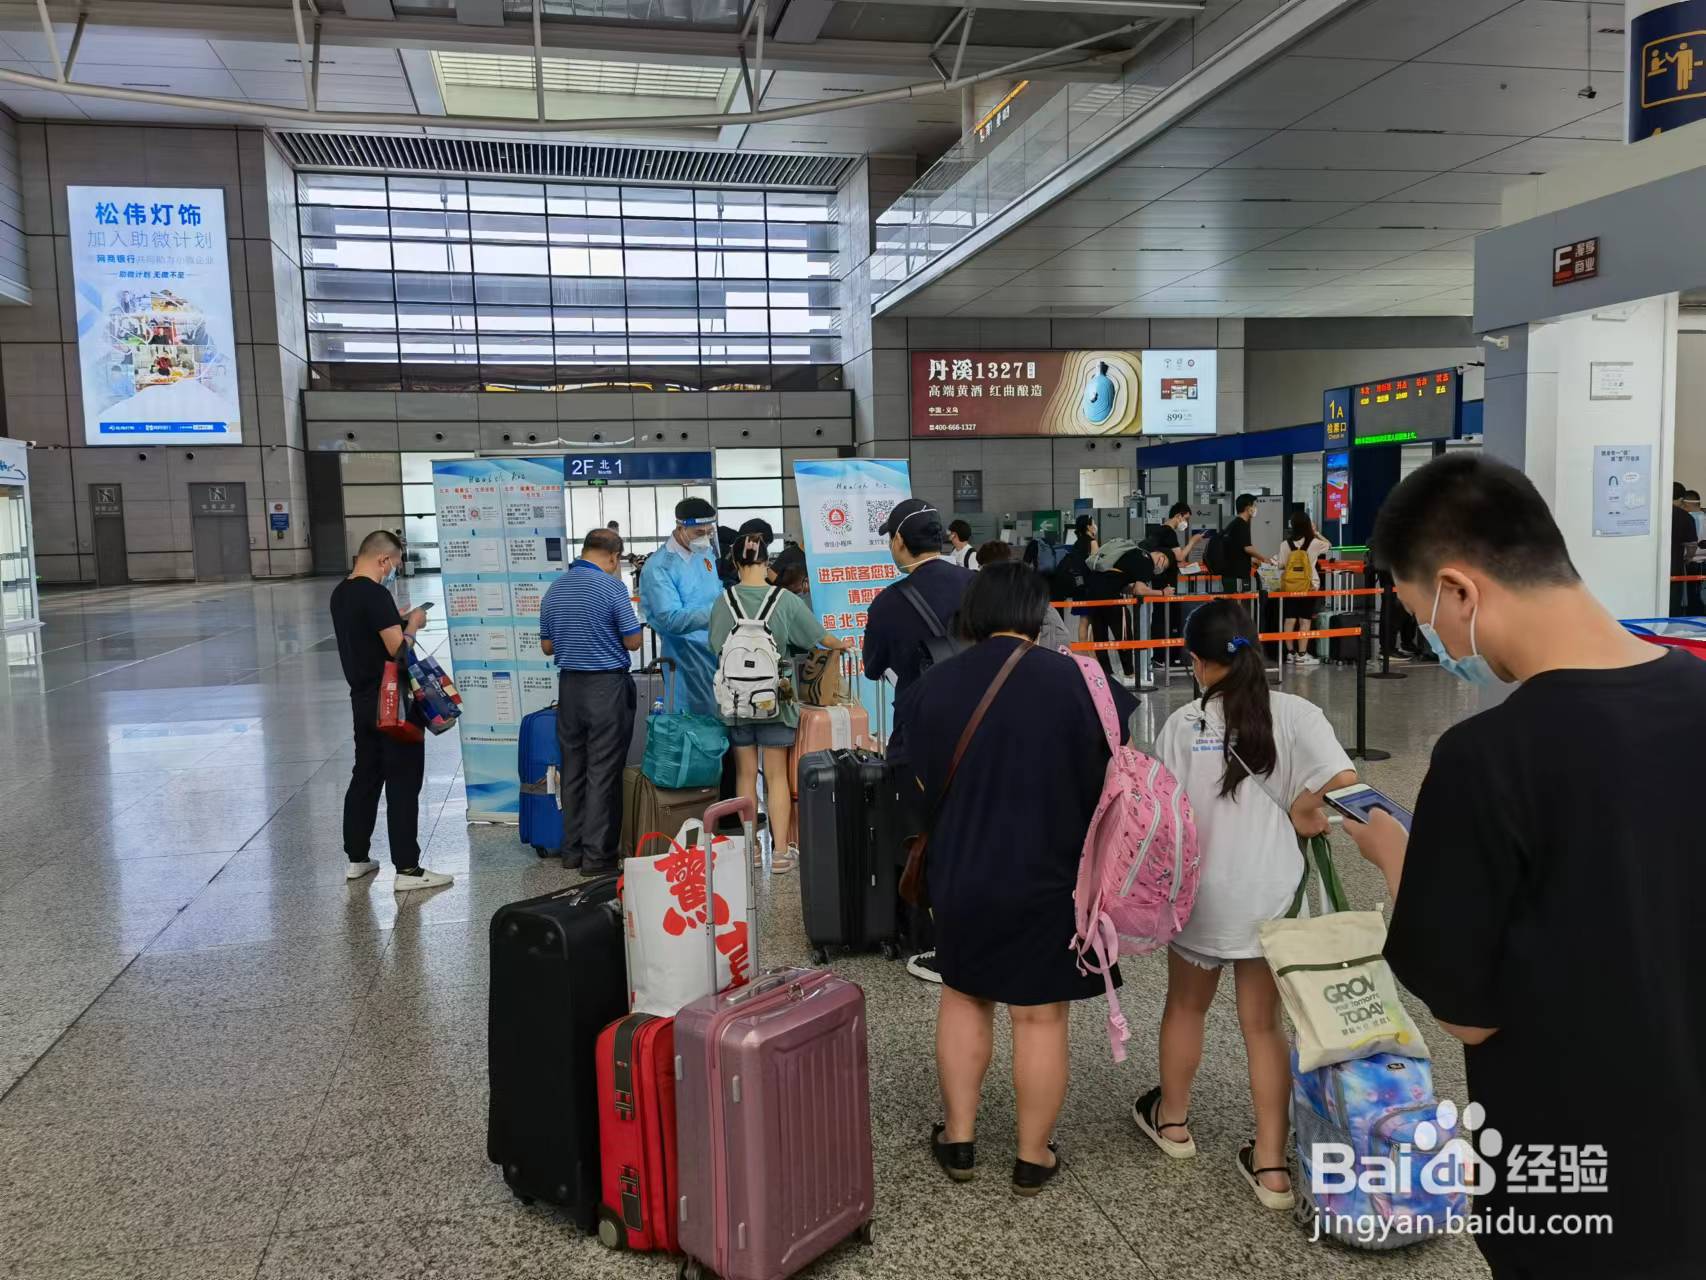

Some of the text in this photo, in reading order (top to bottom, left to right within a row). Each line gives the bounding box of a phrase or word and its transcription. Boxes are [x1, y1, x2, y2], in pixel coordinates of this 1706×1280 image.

[95, 201, 201, 227] 松伟灯饰
[87, 230, 213, 249] 加入助微计划
[928, 358, 1024, 381] 丹溪1327
[928, 384, 1042, 398] 高端黄酒 红曲酿造
[1167, 413, 1183, 422] 899
[1327, 422, 1347, 433] 检票口
[572, 459, 622, 475] 2F 北 1
[1339, 1002, 1384, 1026] TODAY
